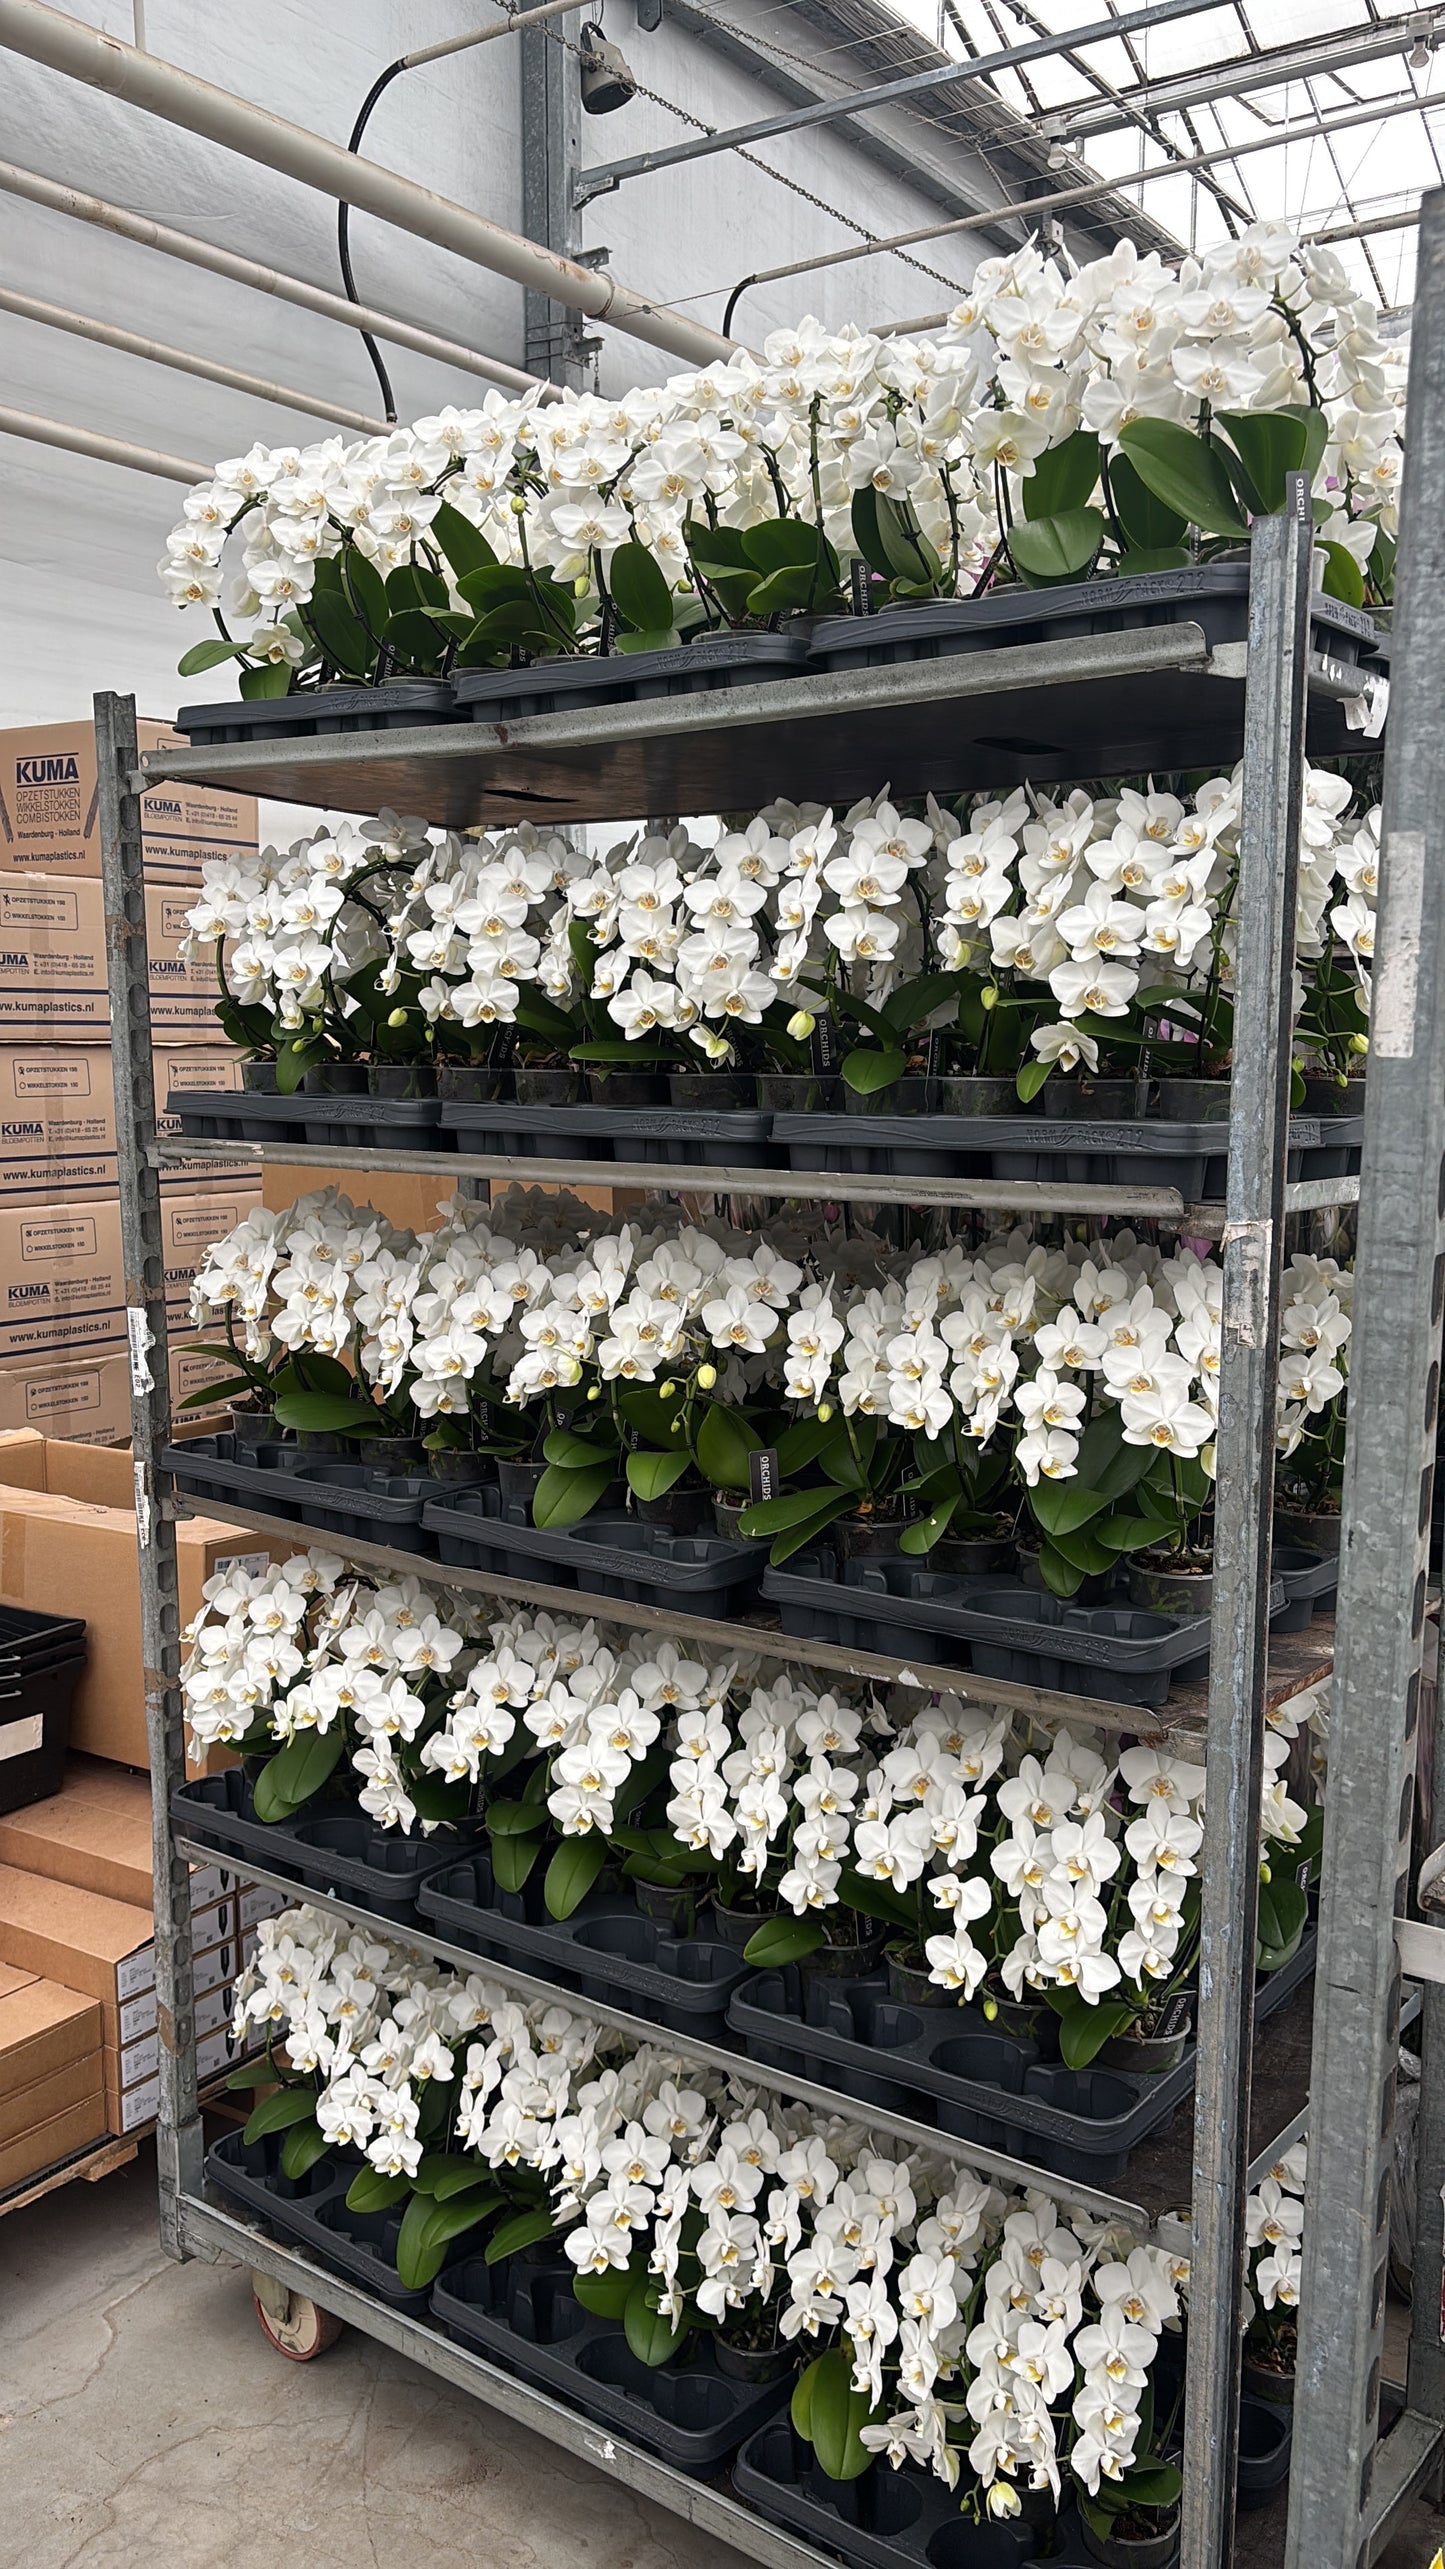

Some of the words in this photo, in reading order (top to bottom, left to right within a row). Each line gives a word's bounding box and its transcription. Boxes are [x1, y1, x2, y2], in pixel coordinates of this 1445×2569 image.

[1296, 478, 1305, 522] ORCHI
[16, 757, 79, 783] KUMA
[16, 788, 80, 802] OPZETSTUKKEN
[17, 799, 80, 812] WIKKELSTOKKEN
[144, 800, 181, 813] KUMA
[16, 811, 80, 824] COMBISTOKKEN
[144, 812, 182, 822] BLOEMPOTTEN
[18, 831, 54, 839] Waardenburg
[13, 850, 85, 862] www.kumaplastics.nl
[145, 846, 228, 861] www.kumaplastics
[150, 961, 186, 972] KUMA
[151, 1006, 216, 1017] www.kumaplas
[499, 1023, 514, 1060] RCHIDS
[818, 1019, 830, 1068] ORCHIDS
[2, 1123, 43, 1135] KUMA
[157, 1119, 182, 1130] KUM
[3, 1164, 106, 1181] www.kumaplastics.nl
[8, 1285, 50, 1299] KUMA
[9, 1320, 110, 1343] www.kumaplastics.nl
[760, 1456, 772, 1501] ORCHIDS
[1164, 1997, 1187, 2036] ORCHIDS
